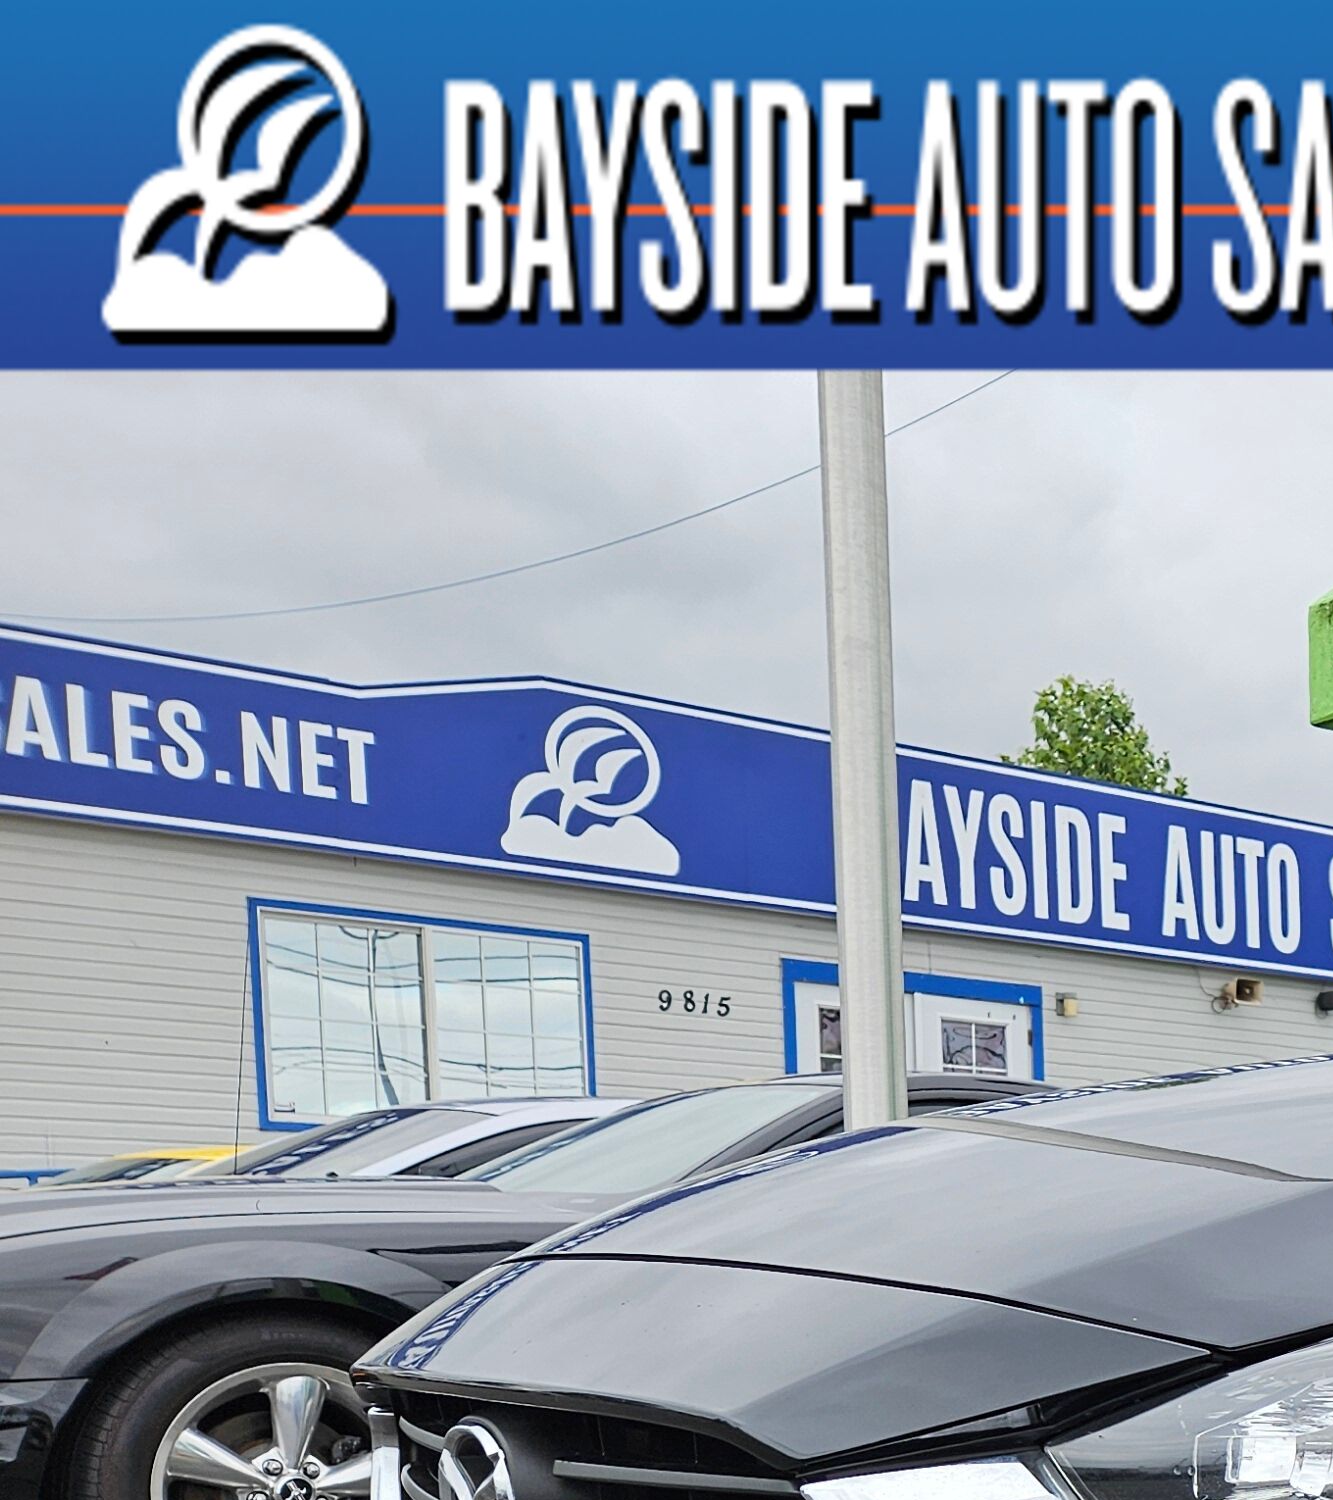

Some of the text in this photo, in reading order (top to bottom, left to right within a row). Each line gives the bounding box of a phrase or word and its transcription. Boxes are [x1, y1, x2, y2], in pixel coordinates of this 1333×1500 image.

[0, 673, 376, 805] ALES.NET
[903, 778, 1131, 931] AYSIDE
[1161, 824, 1301, 954] AUTO
[658, 989, 731, 1017] 9815
